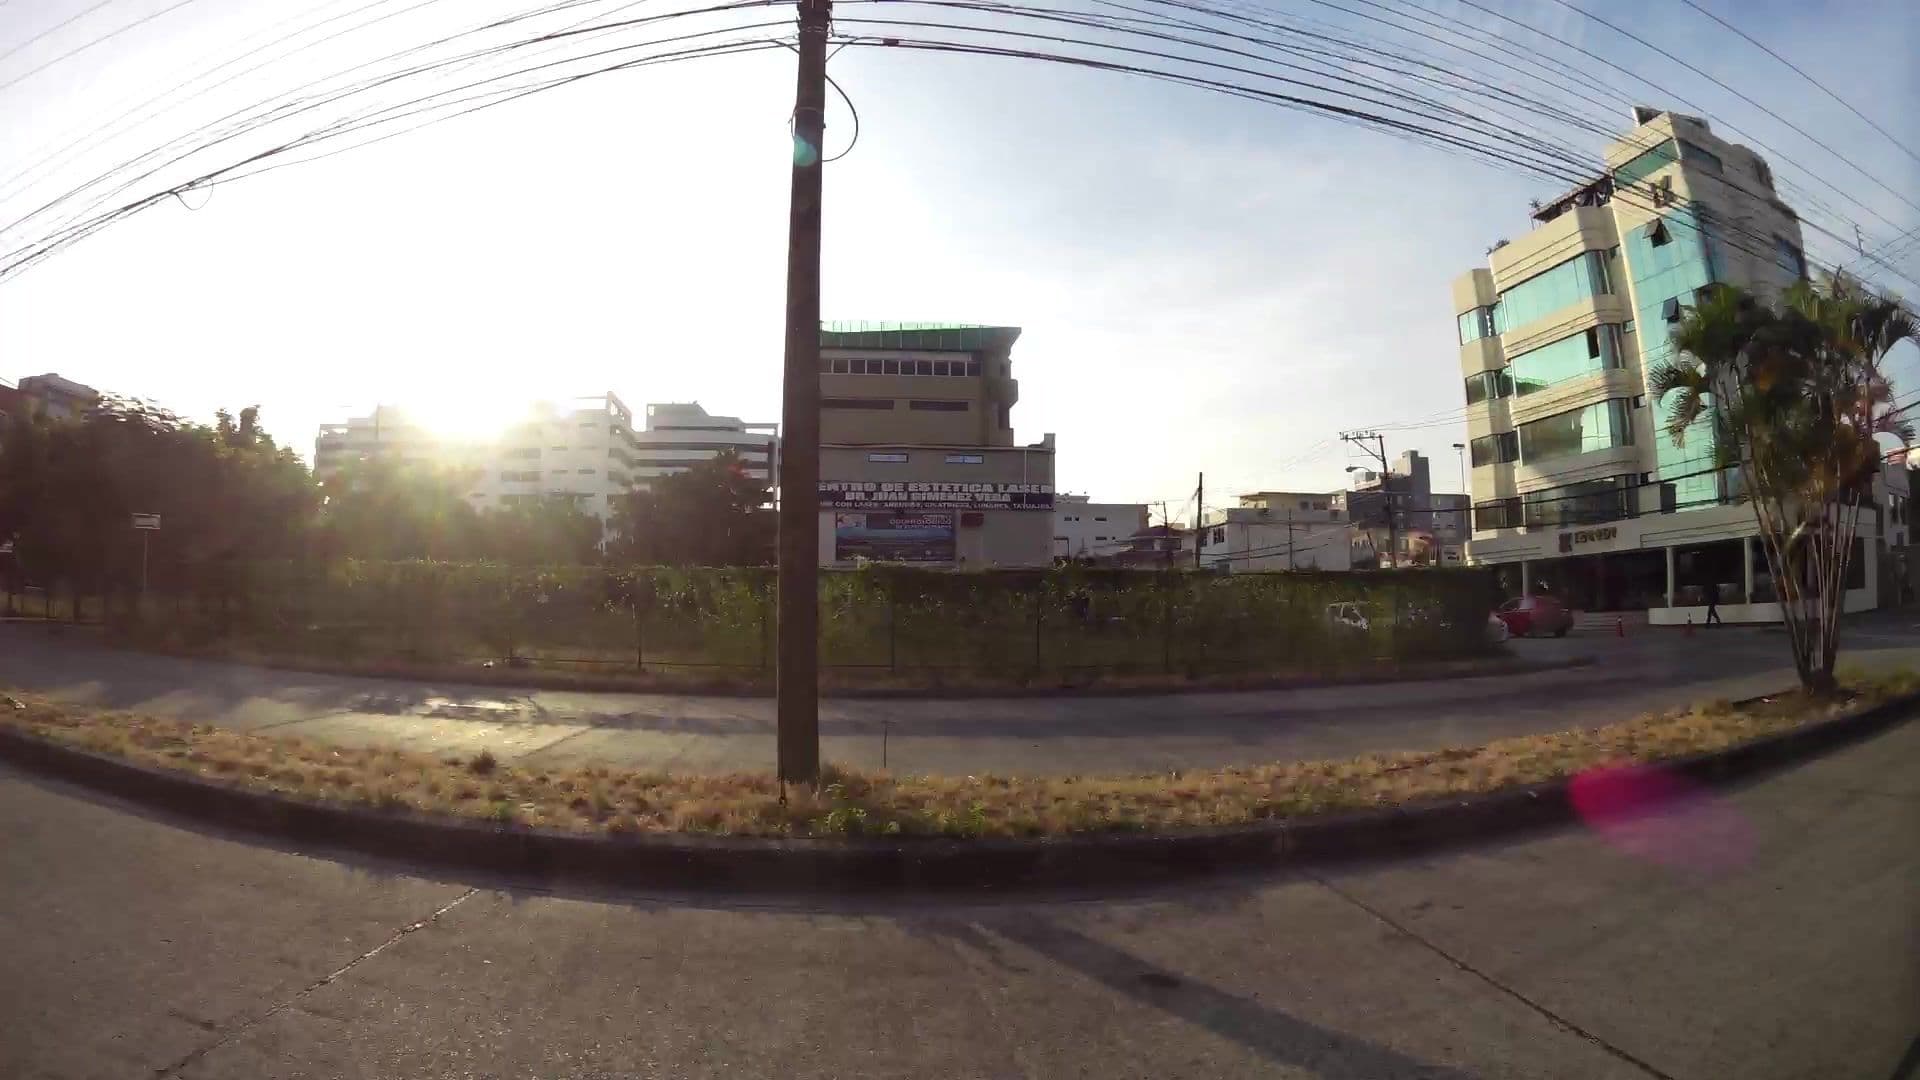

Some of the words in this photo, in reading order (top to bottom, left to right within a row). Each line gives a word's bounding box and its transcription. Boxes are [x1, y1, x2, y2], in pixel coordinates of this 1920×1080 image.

[818, 482, 877, 491] ENTRO
[881, 482, 905, 492] DE
[908, 482, 994, 493] ESTETICA
[998, 483, 1054, 494] LASER
[872, 492, 908, 501] JUAN
